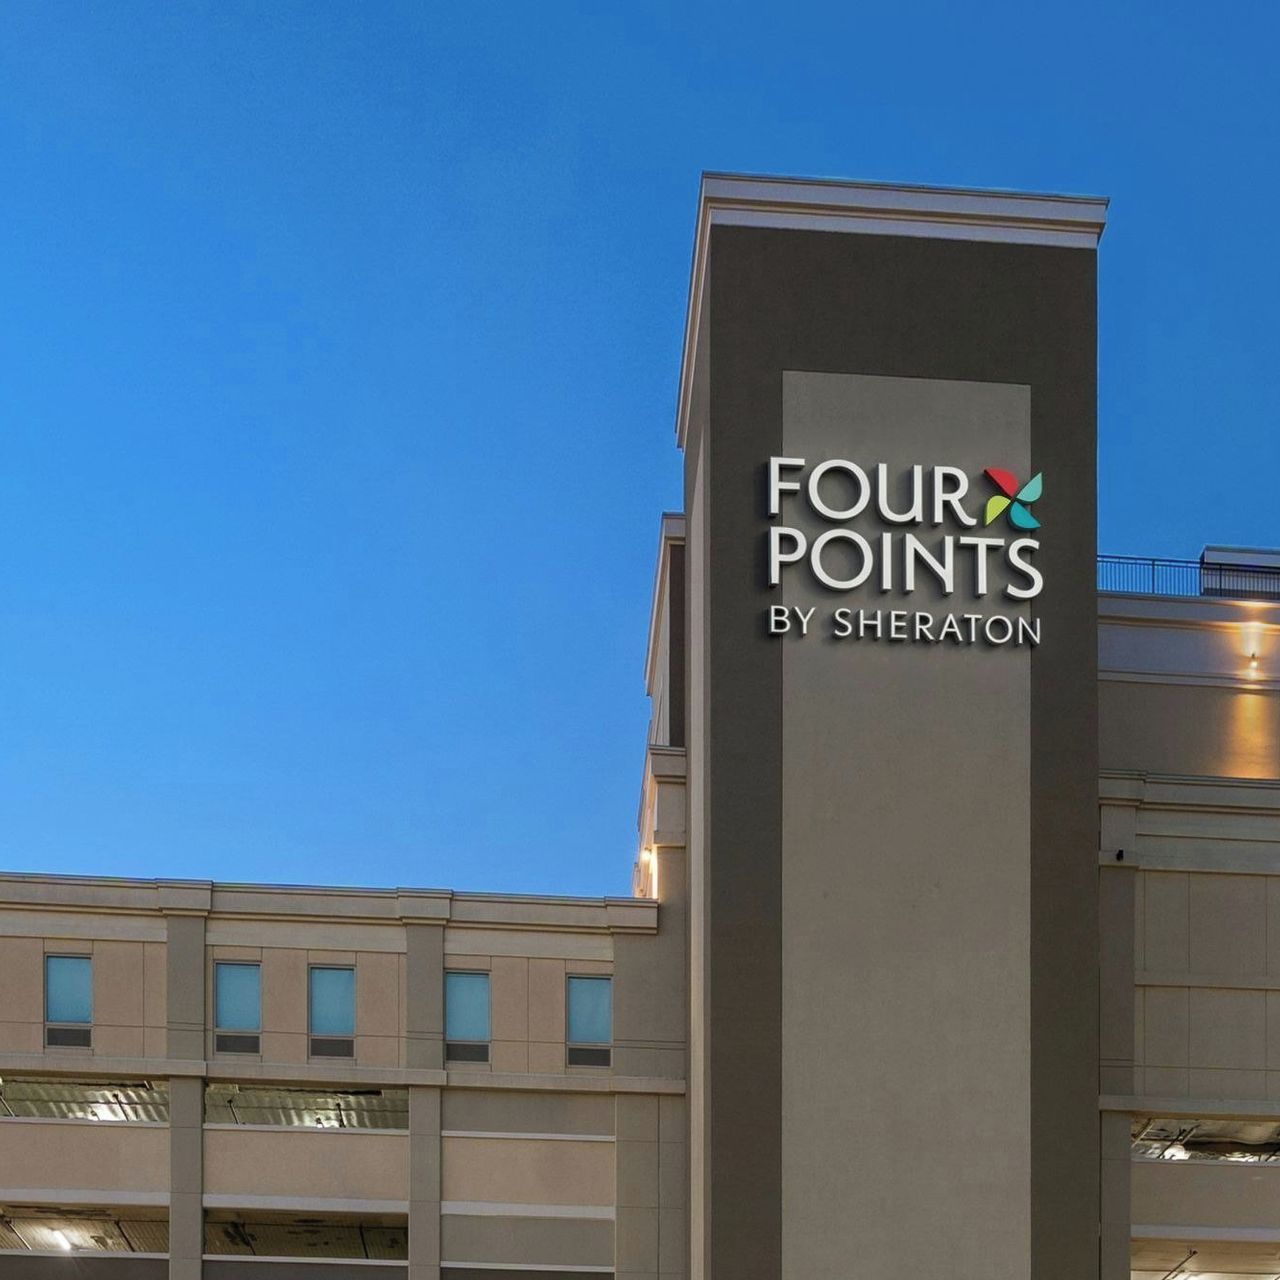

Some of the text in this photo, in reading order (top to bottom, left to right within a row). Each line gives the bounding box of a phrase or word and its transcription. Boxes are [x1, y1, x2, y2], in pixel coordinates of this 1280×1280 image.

[769, 456, 977, 527] FOUR
[769, 526, 1044, 601] POINTS
[769, 605, 1041, 645] BY SHERATON
